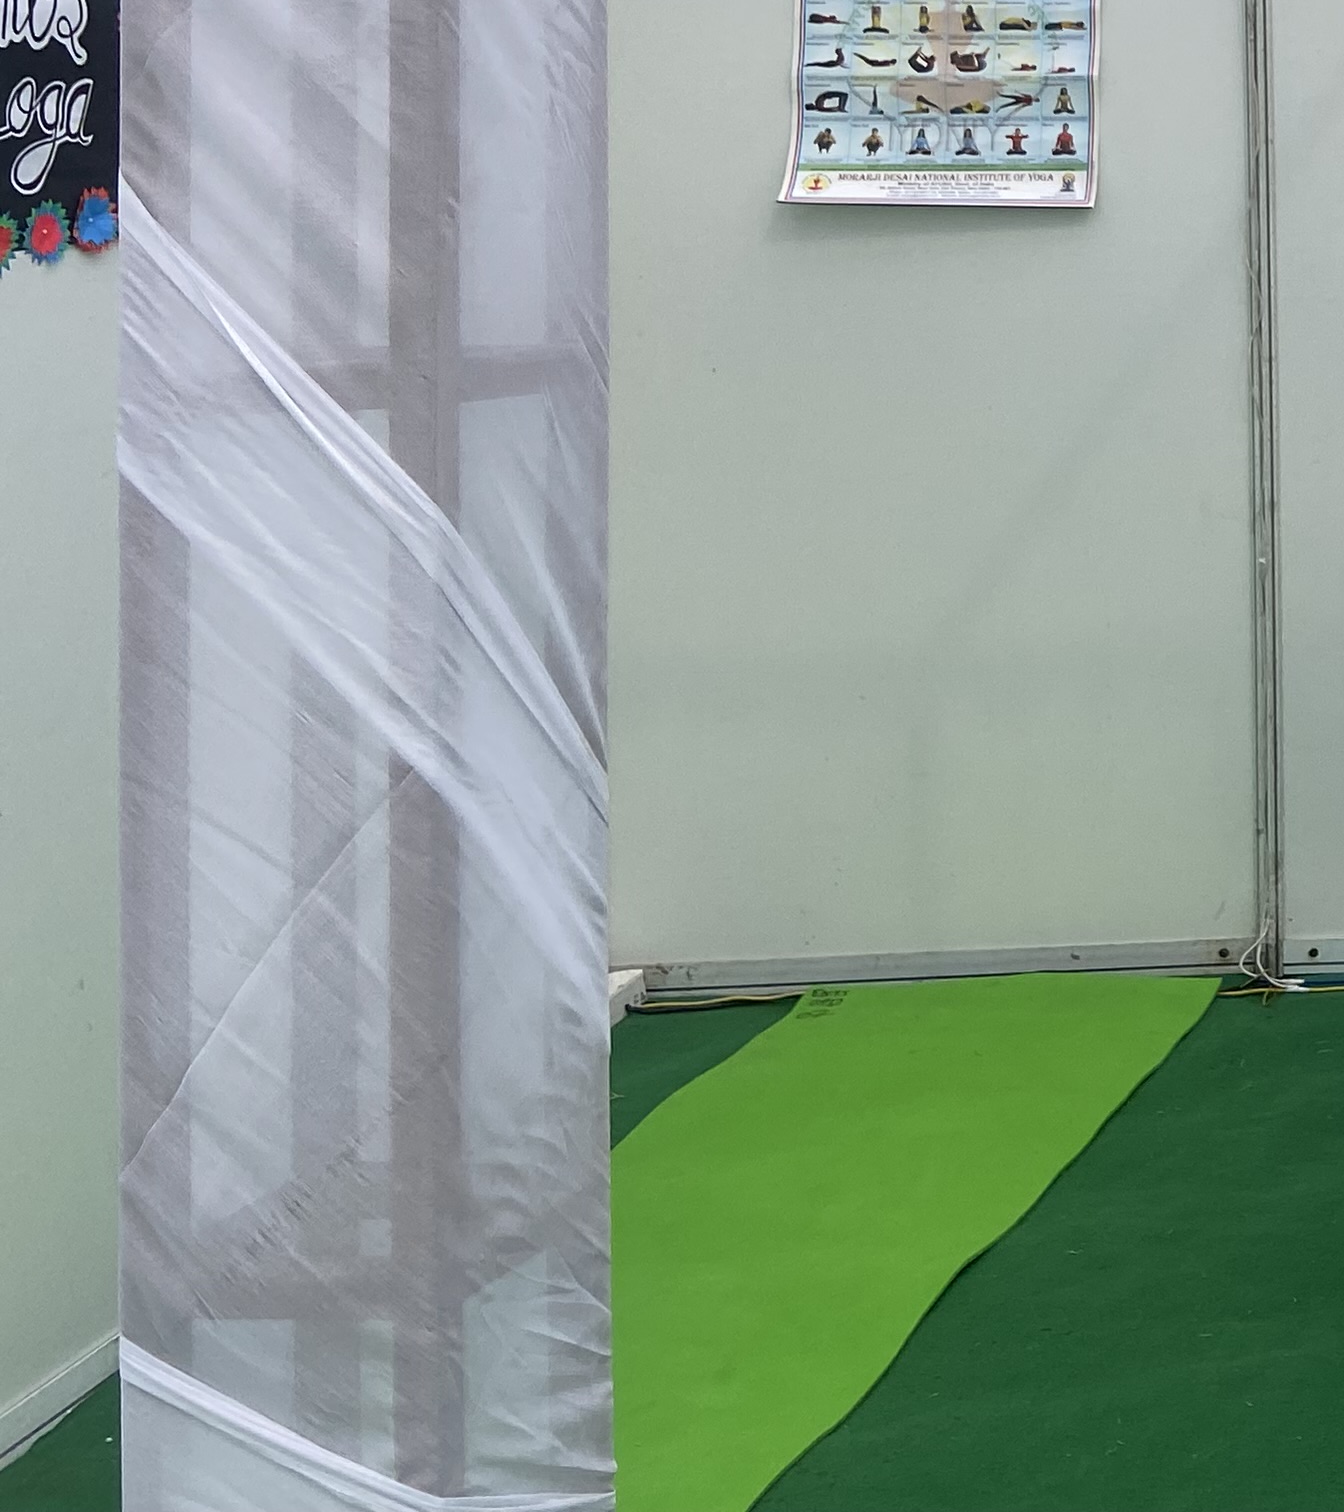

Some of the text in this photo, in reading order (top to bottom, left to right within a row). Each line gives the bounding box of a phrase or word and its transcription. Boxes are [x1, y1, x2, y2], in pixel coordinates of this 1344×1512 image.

[0, 77, 94, 194] oga
[915, 173, 962, 181] NATIONAL
[964, 173, 1011, 182] INSTITUTE
[1013, 173, 1026, 181] OF
[1028, 173, 1054, 181] YOGA
